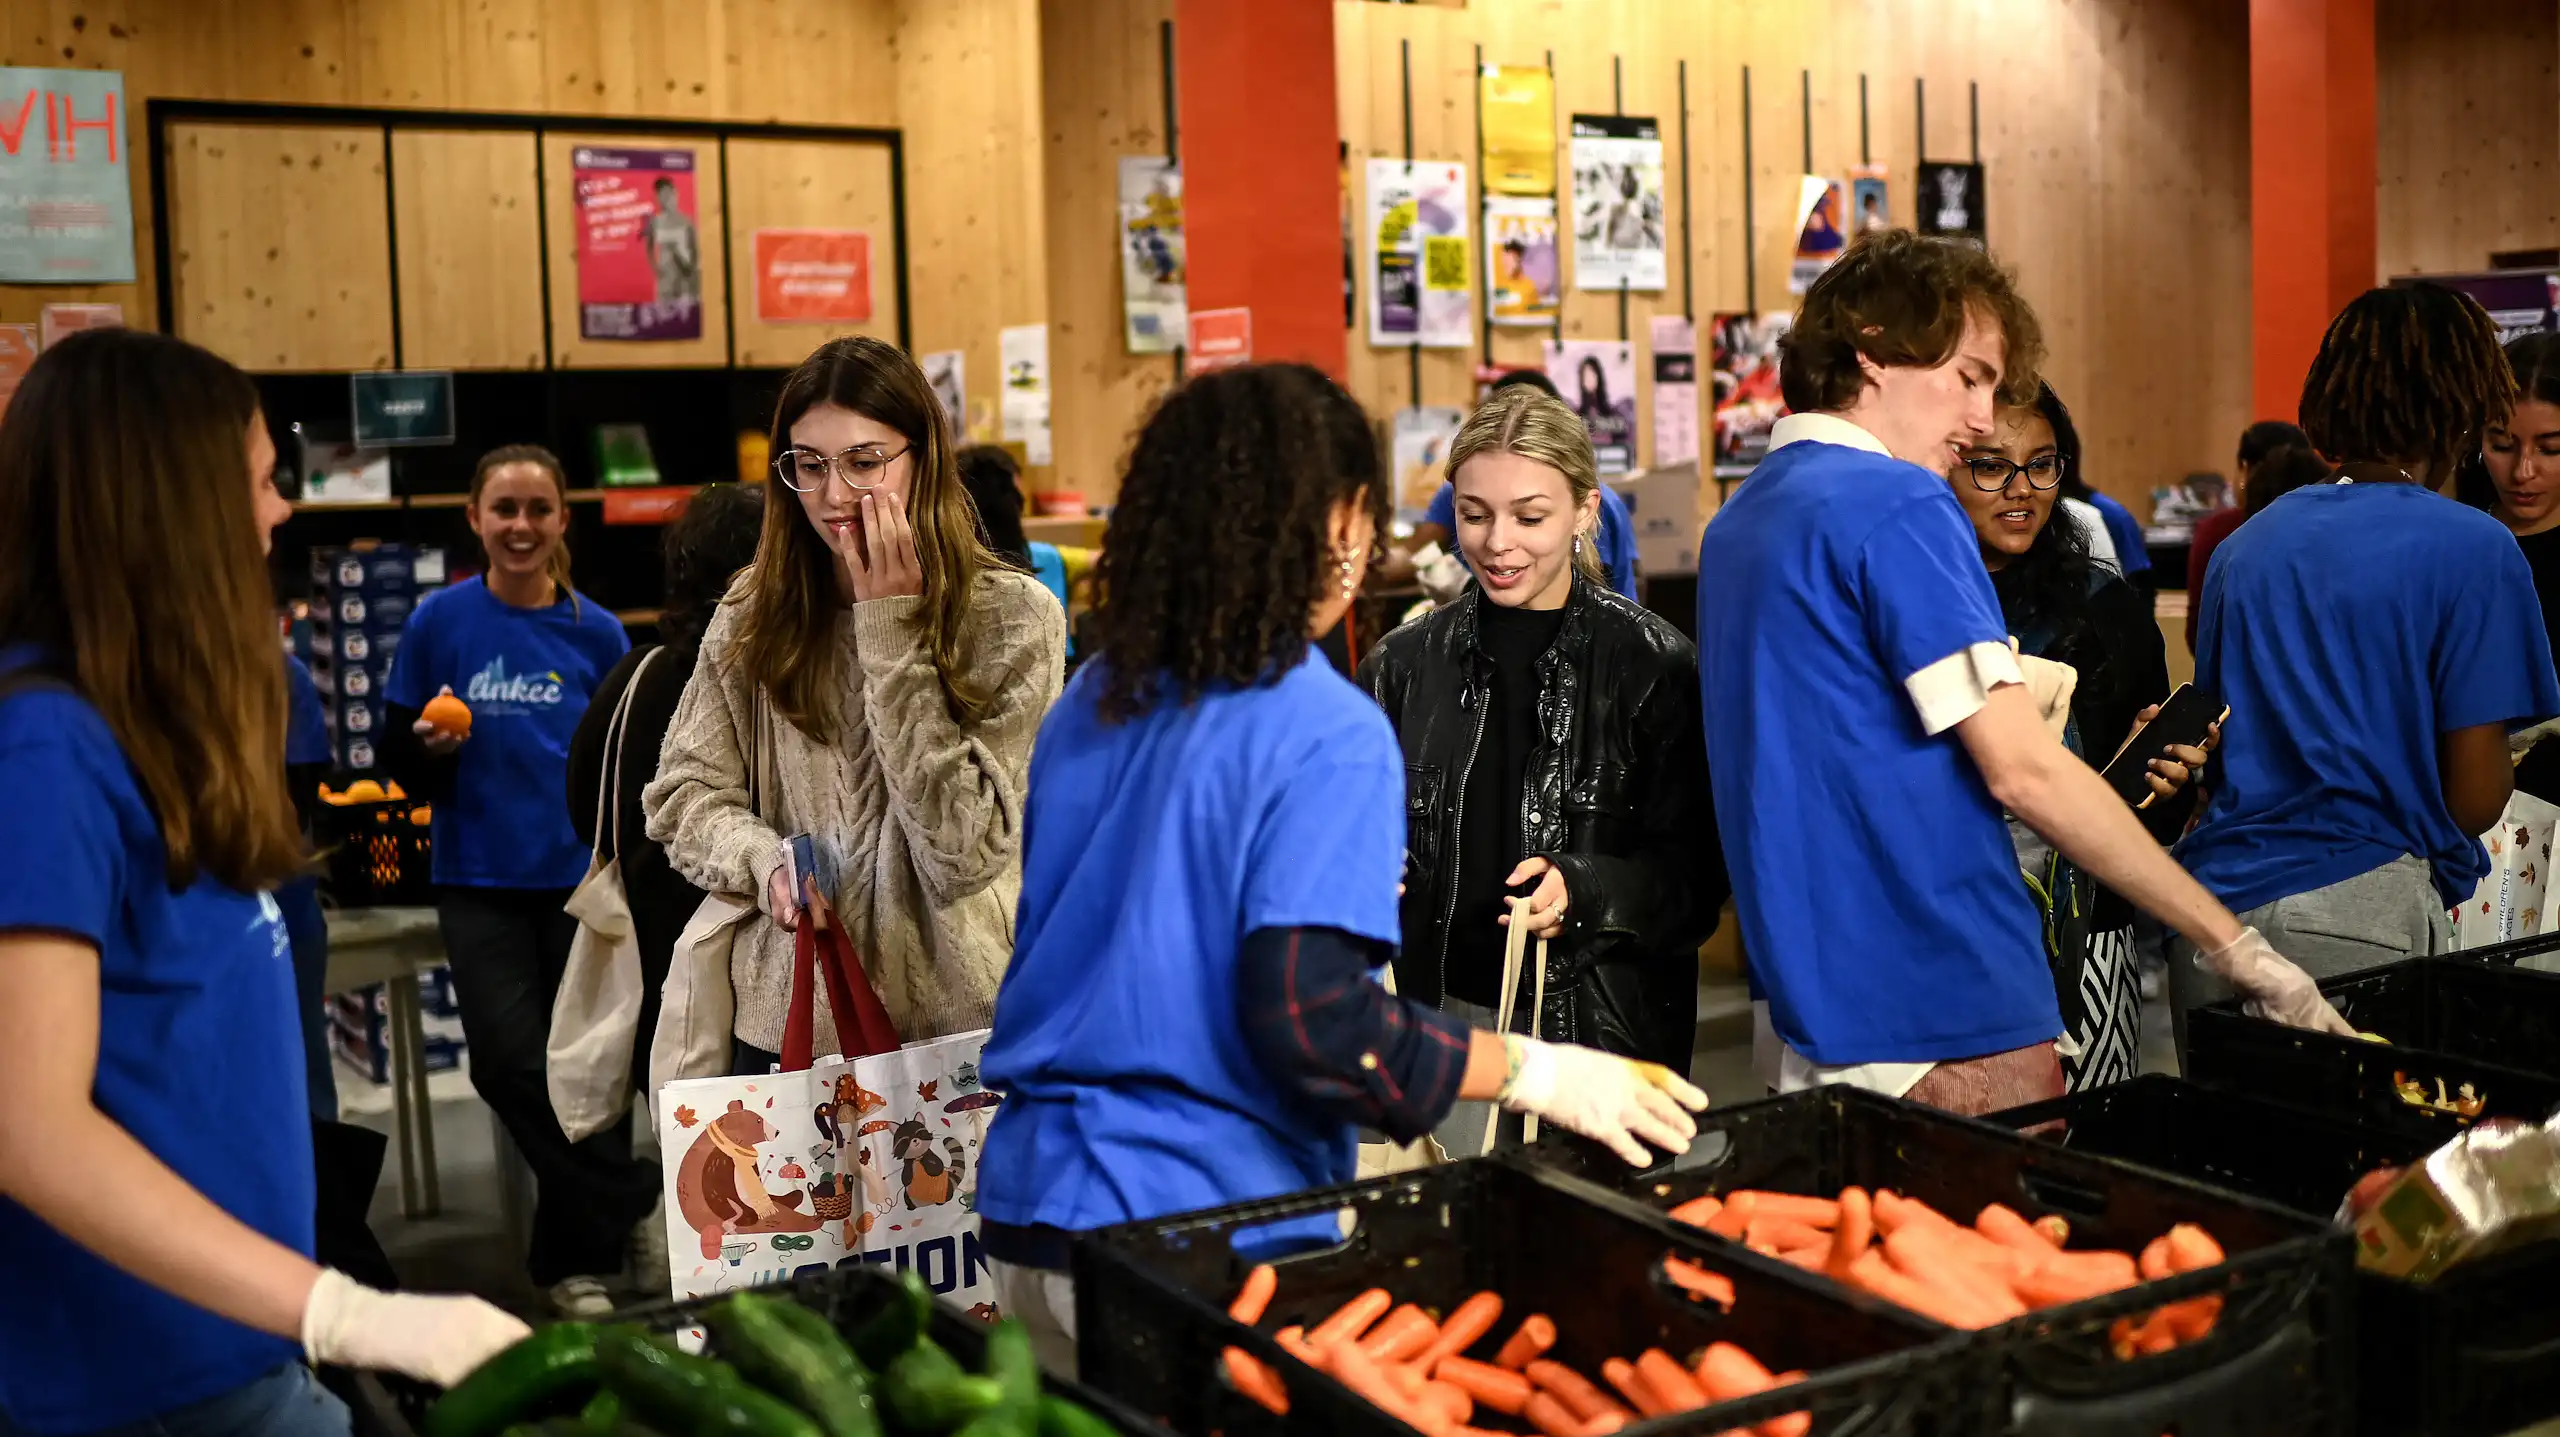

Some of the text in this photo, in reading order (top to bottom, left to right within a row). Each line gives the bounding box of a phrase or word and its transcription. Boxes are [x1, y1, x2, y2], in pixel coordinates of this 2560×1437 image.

[0, 88, 117, 164] VIH
[2499, 868, 2510, 932] CHILDREN'S
[2506, 907, 2515, 940] AGES
[793, 1230, 992, 1296] TION
